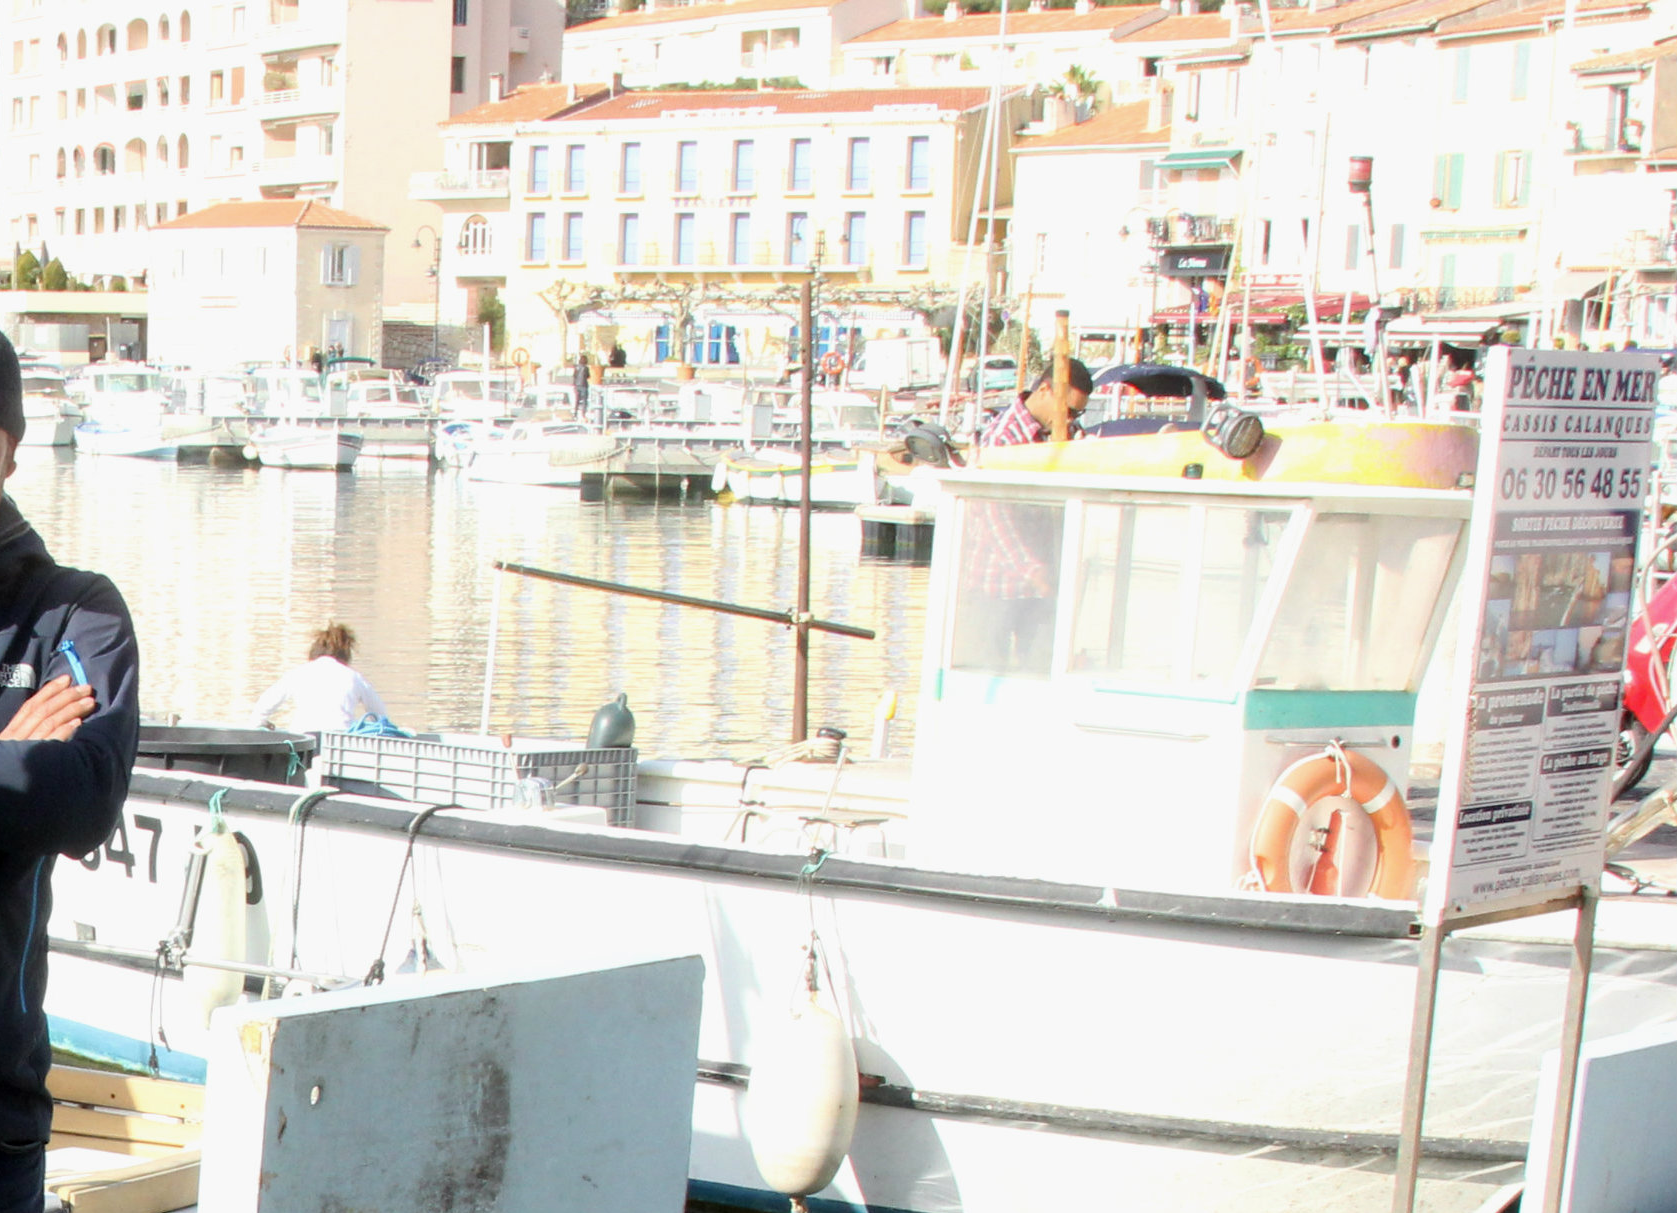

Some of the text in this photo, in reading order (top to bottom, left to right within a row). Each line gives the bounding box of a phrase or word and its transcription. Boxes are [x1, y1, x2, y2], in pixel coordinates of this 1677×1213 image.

[1508, 355, 1657, 403] PÊCHE EN MER
[1502, 413, 1652, 438] CASSIS CALANQUES
[1501, 467, 1642, 500] 06 30 56 48 55
